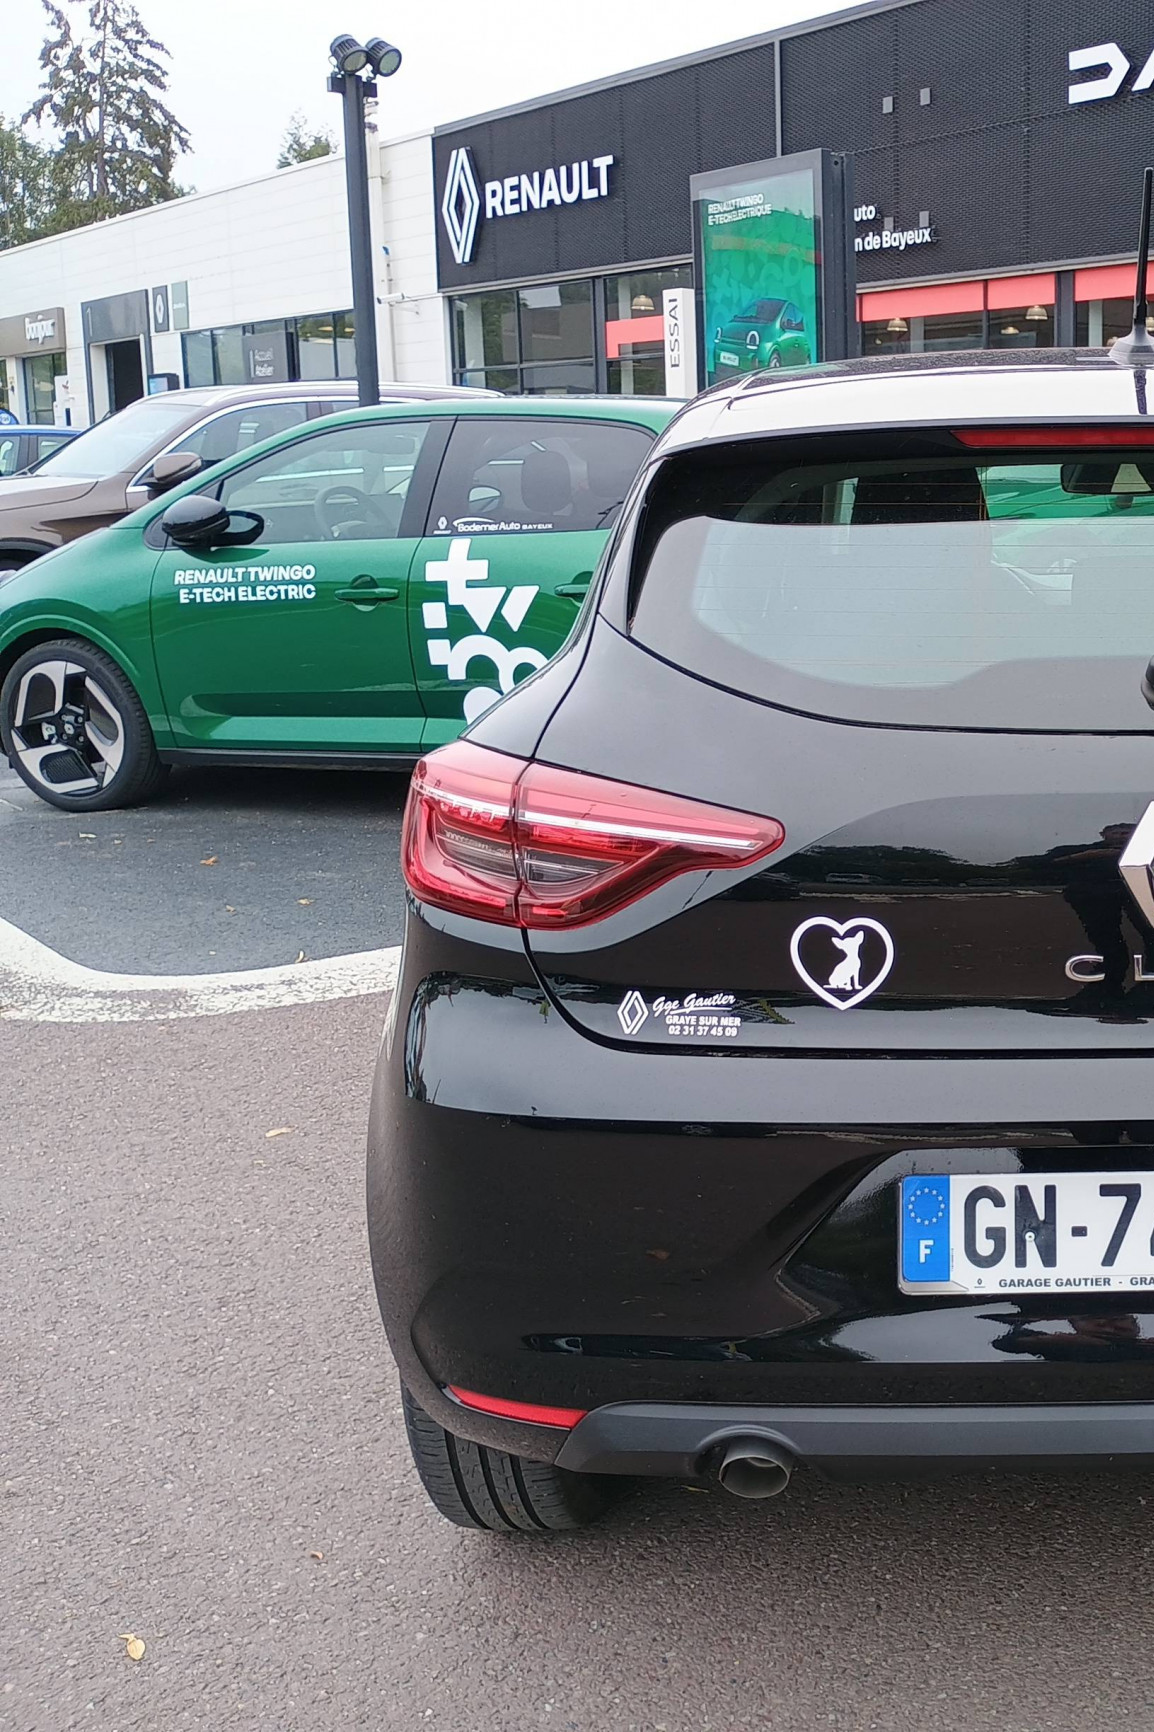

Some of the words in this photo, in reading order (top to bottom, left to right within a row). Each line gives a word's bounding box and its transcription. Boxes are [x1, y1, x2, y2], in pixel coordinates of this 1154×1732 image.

[484, 154, 614, 219] RENAULT
[708, 197, 737, 214] RENAULT
[737, 193, 764, 208] TWINGO
[853, 204, 876, 222] uto
[854, 237, 863, 252] n
[864, 231, 881, 251] de
[882, 227, 932, 250] Bayeux
[667, 297, 680, 368] ESSAI
[174, 566, 246, 585] RENAULT
[247, 564, 316, 582] TWINGO
[179, 586, 236, 604] E-TECH
[238, 584, 316, 602] ELECTRIC
[683, 993, 736, 1013] Gautier
[665, 1015, 696, 1025] GRAYE
[698, 1016, 718, 1026] SUR
[720, 1017, 741, 1027] MER
[668, 1026, 680, 1035] 02
[683, 1026, 694, 1035] 31
[697, 1026, 708, 1035] 37
[710, 1027, 722, 1036] 45
[724, 1027, 737, 1037] 09
[919, 1239, 934, 1264] F
[998, 1278, 1051, 1288] GARAGE
[1055, 1276, 1112, 1287] GAUTIER
